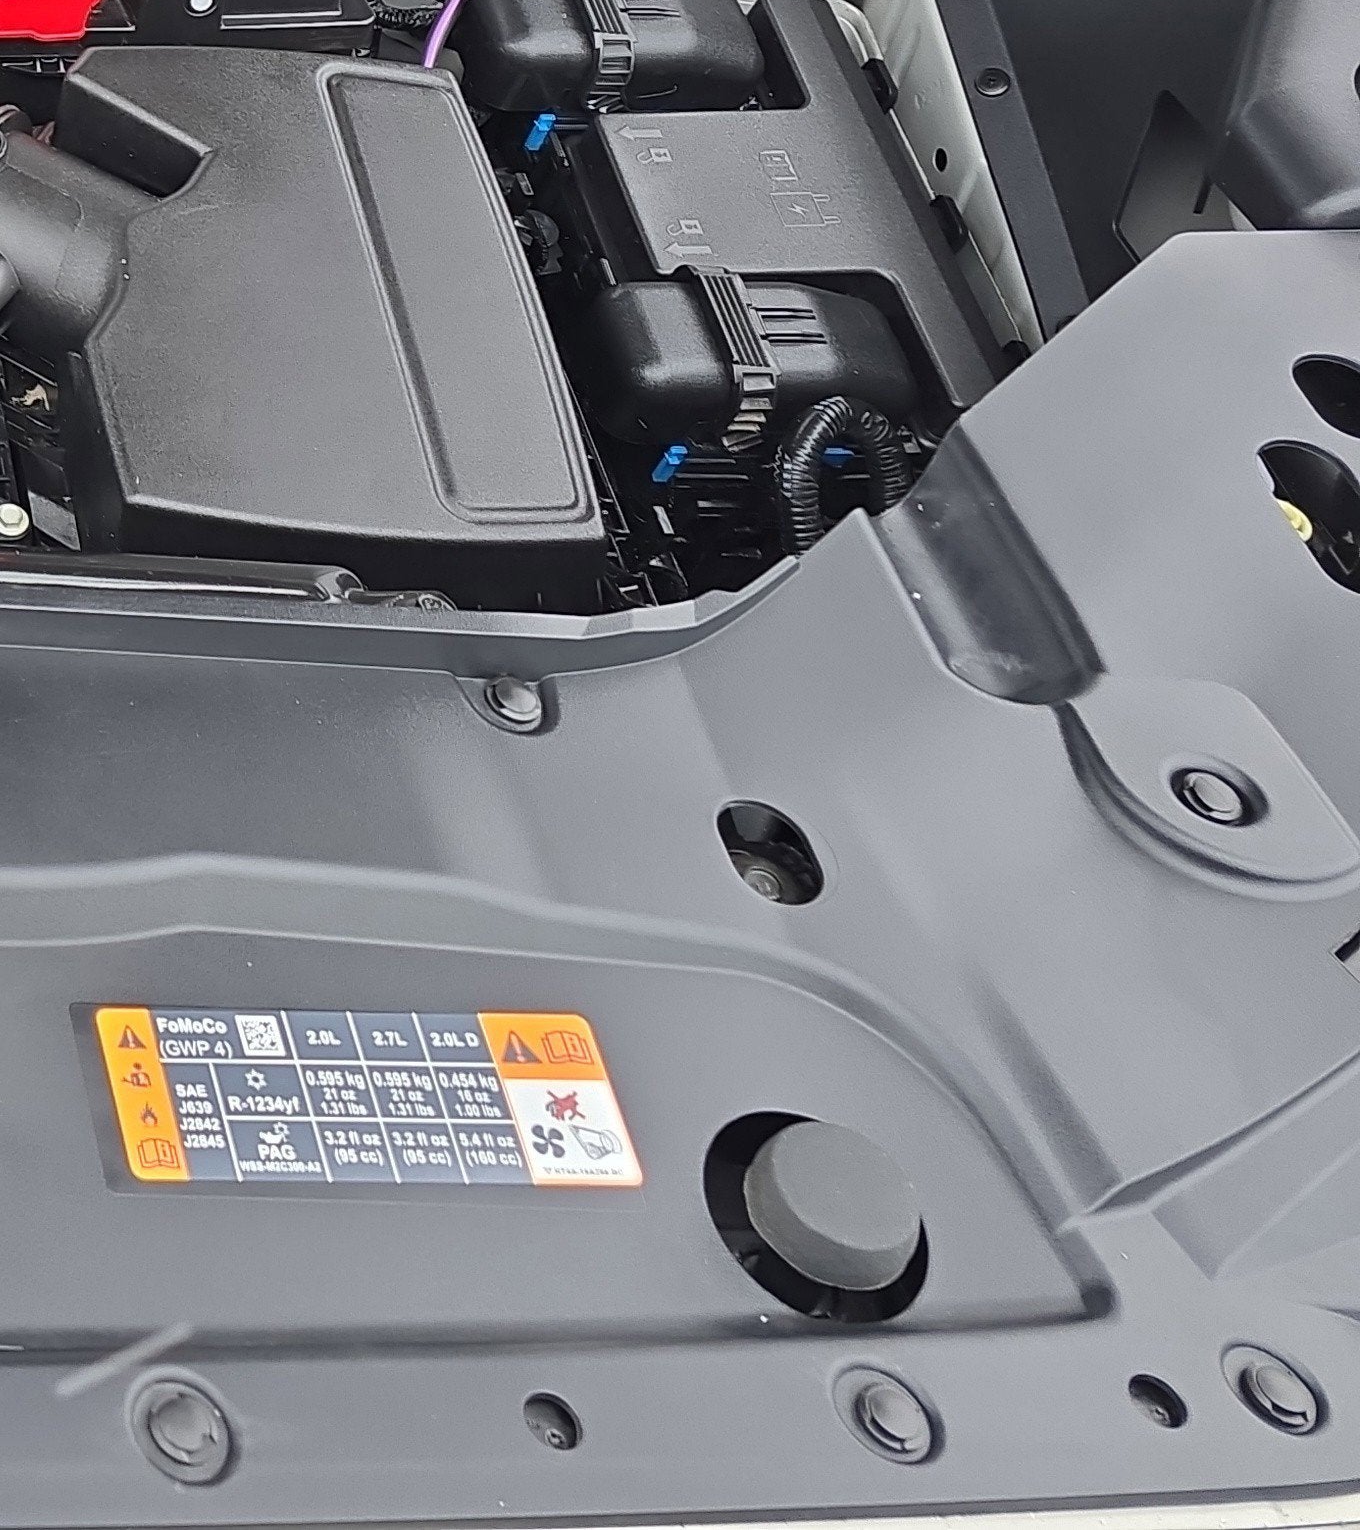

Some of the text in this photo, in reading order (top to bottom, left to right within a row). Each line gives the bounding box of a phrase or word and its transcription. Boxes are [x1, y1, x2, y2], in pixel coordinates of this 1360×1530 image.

[155, 1016, 227, 1036] FoMoCo
[306, 1029, 342, 1046] 2.0L
[372, 1030, 408, 1047] 2.7L
[430, 1032, 479, 1047] 2.0L D
[159, 1039, 233, 1060] (GWP 4)
[306, 1070, 364, 1090] 0.595 kg
[373, 1071, 432, 1091] 0.595 kg
[438, 1072, 499, 1092] 0.454 kg
[176, 1083, 208, 1098] SAE
[323, 1088, 357, 1101] 21 oz
[390, 1088, 425, 1102] 21 oz
[458, 1089, 492, 1102] 16 oz
[178, 1099, 213, 1114] J639
[228, 1094, 300, 1116] R-1234yf
[321, 1102, 368, 1116] 1.31 lbs
[389, 1103, 436, 1117] 1.31 lbs
[455, 1104, 502, 1118] 1.00 lbs
[324, 1131, 382, 1146] 3.2 fl oz
[392, 1131, 450, 1147] 3.2 fl oz
[459, 1132, 516, 1148] 5.4 fl oz
[258, 1143, 297, 1160] PAG
[334, 1147, 384, 1167] (95 cc)
[403, 1148, 452, 1168] (95 cc)
[465, 1149, 523, 1169] (160 cc)
